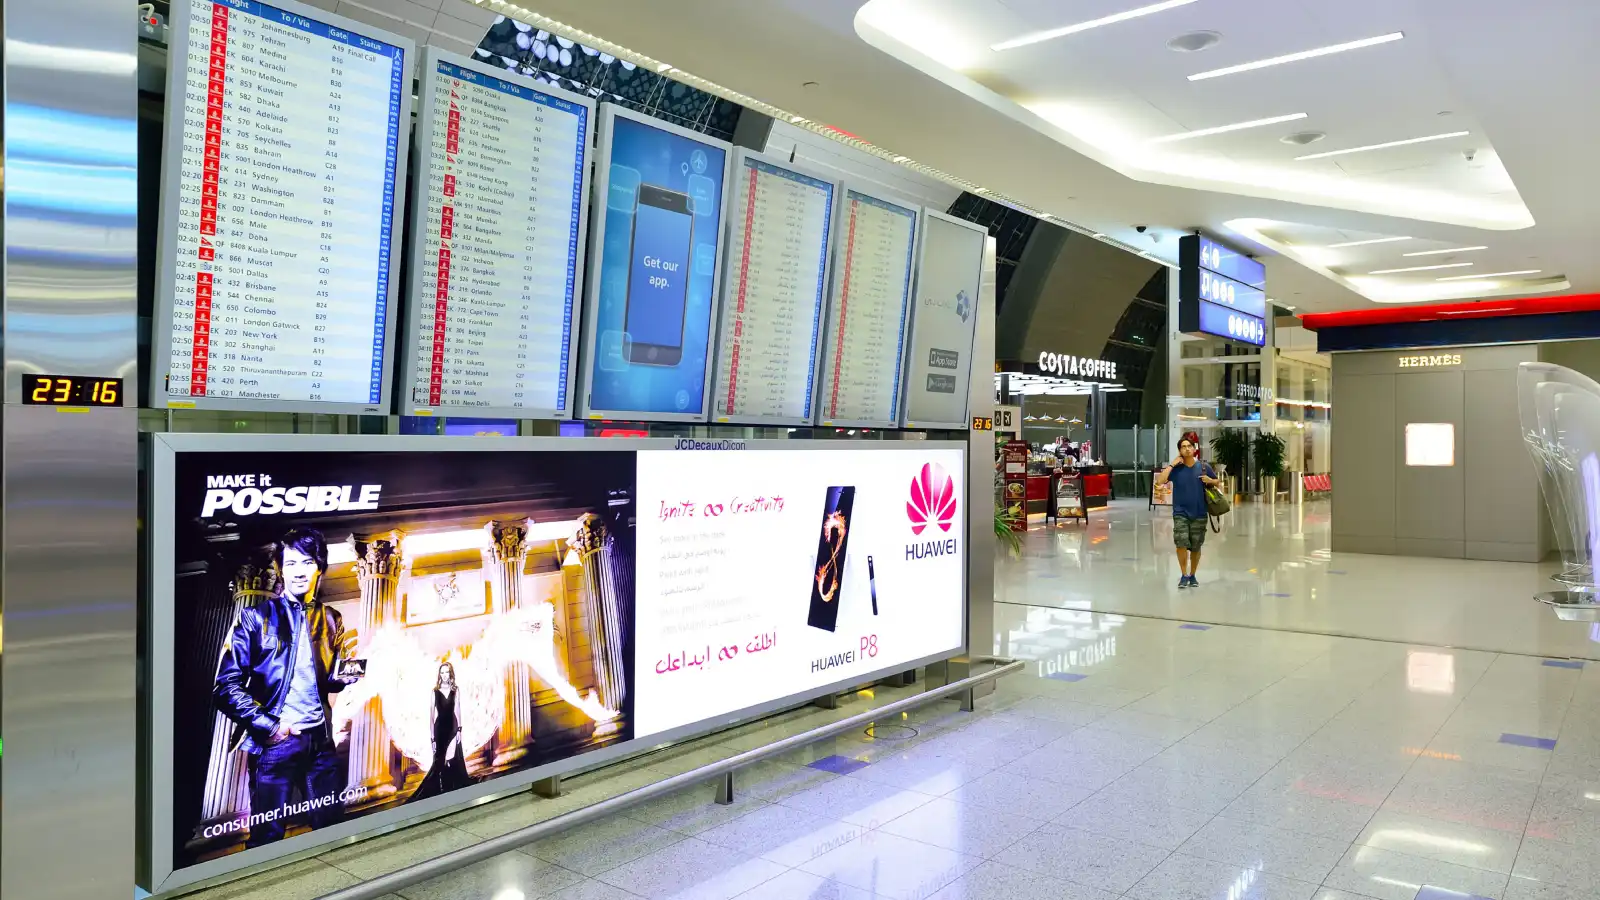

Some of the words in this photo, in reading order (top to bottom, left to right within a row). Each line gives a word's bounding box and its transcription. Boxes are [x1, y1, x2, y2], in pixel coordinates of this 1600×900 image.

[190, 13, 210, 25] 00:50
[260, 34, 286, 48] Tehran
[191, 0, 211, 12] 23:20
[261, 21, 311, 44] Johannesburg
[281, 13, 290, 22] To
[298, 18, 310, 28] Via
[330, 29, 347, 39] Gate
[360, 38, 381, 50] Status
[189, 39, 209, 51] 01:30
[259, 59, 286, 72] Karachi
[190, 26, 209, 38] 01:15
[259, 46, 287, 60] Medina
[187, 65, 207, 77] 01:45
[257, 84, 284, 97] Kuwait
[188, 52, 208, 64] 01:35
[258, 71, 298, 88] Melbourne
[187, 78, 206, 90] 02:00
[256, 96, 280, 108] Dhaka
[185, 105, 205, 116] 02:05
[255, 121, 283, 134] Kolkata
[186, 92, 206, 103] 02:05
[256, 109, 288, 123] Adelaide
[184, 118, 204, 129] 02:05
[254, 134, 292, 148] Seychelles
[184, 131, 203, 142] 02:05
[254, 146, 282, 158] Bahrain
[182, 157, 202, 167] 02:15
[252, 171, 279, 184] Sydney
[183, 144, 203, 154] 02:15
[253, 158, 280, 170] London
[282, 165, 316, 178] Heathrow
[181, 183, 200, 193] 02:25
[182, 170, 201, 180] 02:20
[251, 183, 295, 198] Washington
[179, 209, 199, 218] 02:30
[249, 220, 268, 229] Male
[180, 196, 200, 206] 02:30
[250, 208, 278, 219] London
[279, 213, 314, 225] Heathrow
[178, 222, 198, 231] 02:30
[177, 247, 197, 256] 02:40
[178, 234, 197, 244] 02:40
[248, 245, 269, 254] Kuala
[270, 248, 297, 258] Lumpur
[176, 260, 196, 269] 02:45
[246, 269, 268, 278] Dallas
[643, 255, 660, 269] Get
[663, 261, 679, 273] our
[175, 286, 194, 294] 02:45
[244, 294, 275, 303] Chennai
[176, 273, 195, 282] 02:45
[245, 282, 277, 291] Brisbane
[649, 275, 670, 288] app.
[173, 311, 193, 320] 02:50
[243, 318, 270, 327] London
[272, 321, 300, 330] Gatwick
[174, 299, 194, 307] 02:45
[244, 306, 276, 315] Colombo
[173, 324, 192, 332] 02:50
[241, 342, 276, 352] Shanghai
[1039, 351, 1078, 375] COSTA
[1079, 357, 1116, 379] COFFEE
[32, 378, 118, 403] 23:16
[207, 474, 256, 488] MAKE
[260, 473, 271, 487] it
[201, 484, 382, 518] POSSIBLE
[658, 500, 696, 522] Ignite
[905, 538, 957, 561] HUAWEI
[811, 650, 855, 673] HUAWEI
[860, 634, 878, 660] P8
[203, 784, 368, 839] consumer.huawei.com
